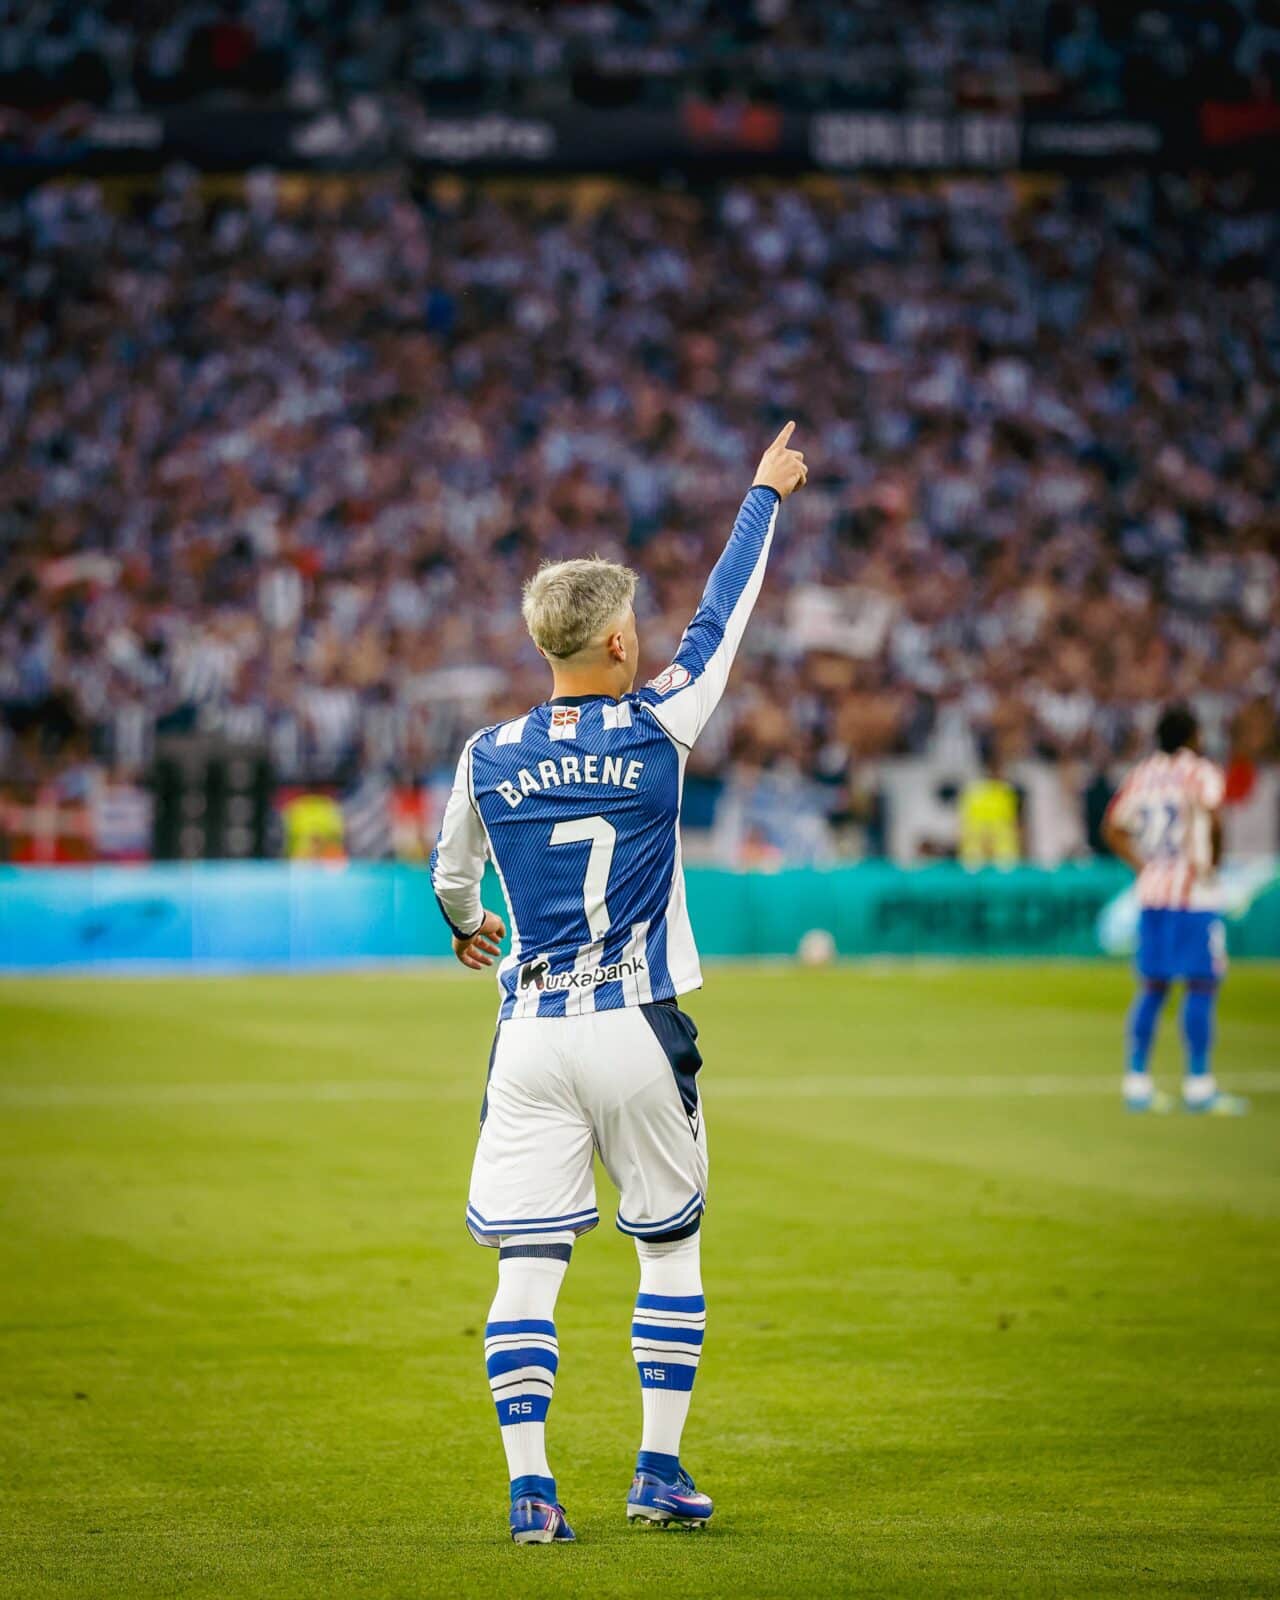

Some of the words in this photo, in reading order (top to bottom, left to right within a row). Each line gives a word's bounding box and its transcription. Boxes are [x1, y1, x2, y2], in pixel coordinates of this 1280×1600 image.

[495, 755, 645, 809] BARRENE
[549, 815, 617, 944] 7
[520, 956, 646, 991] Kutxabank
[643, 1367, 666, 1381] RS
[508, 1401, 533, 1416] RS
